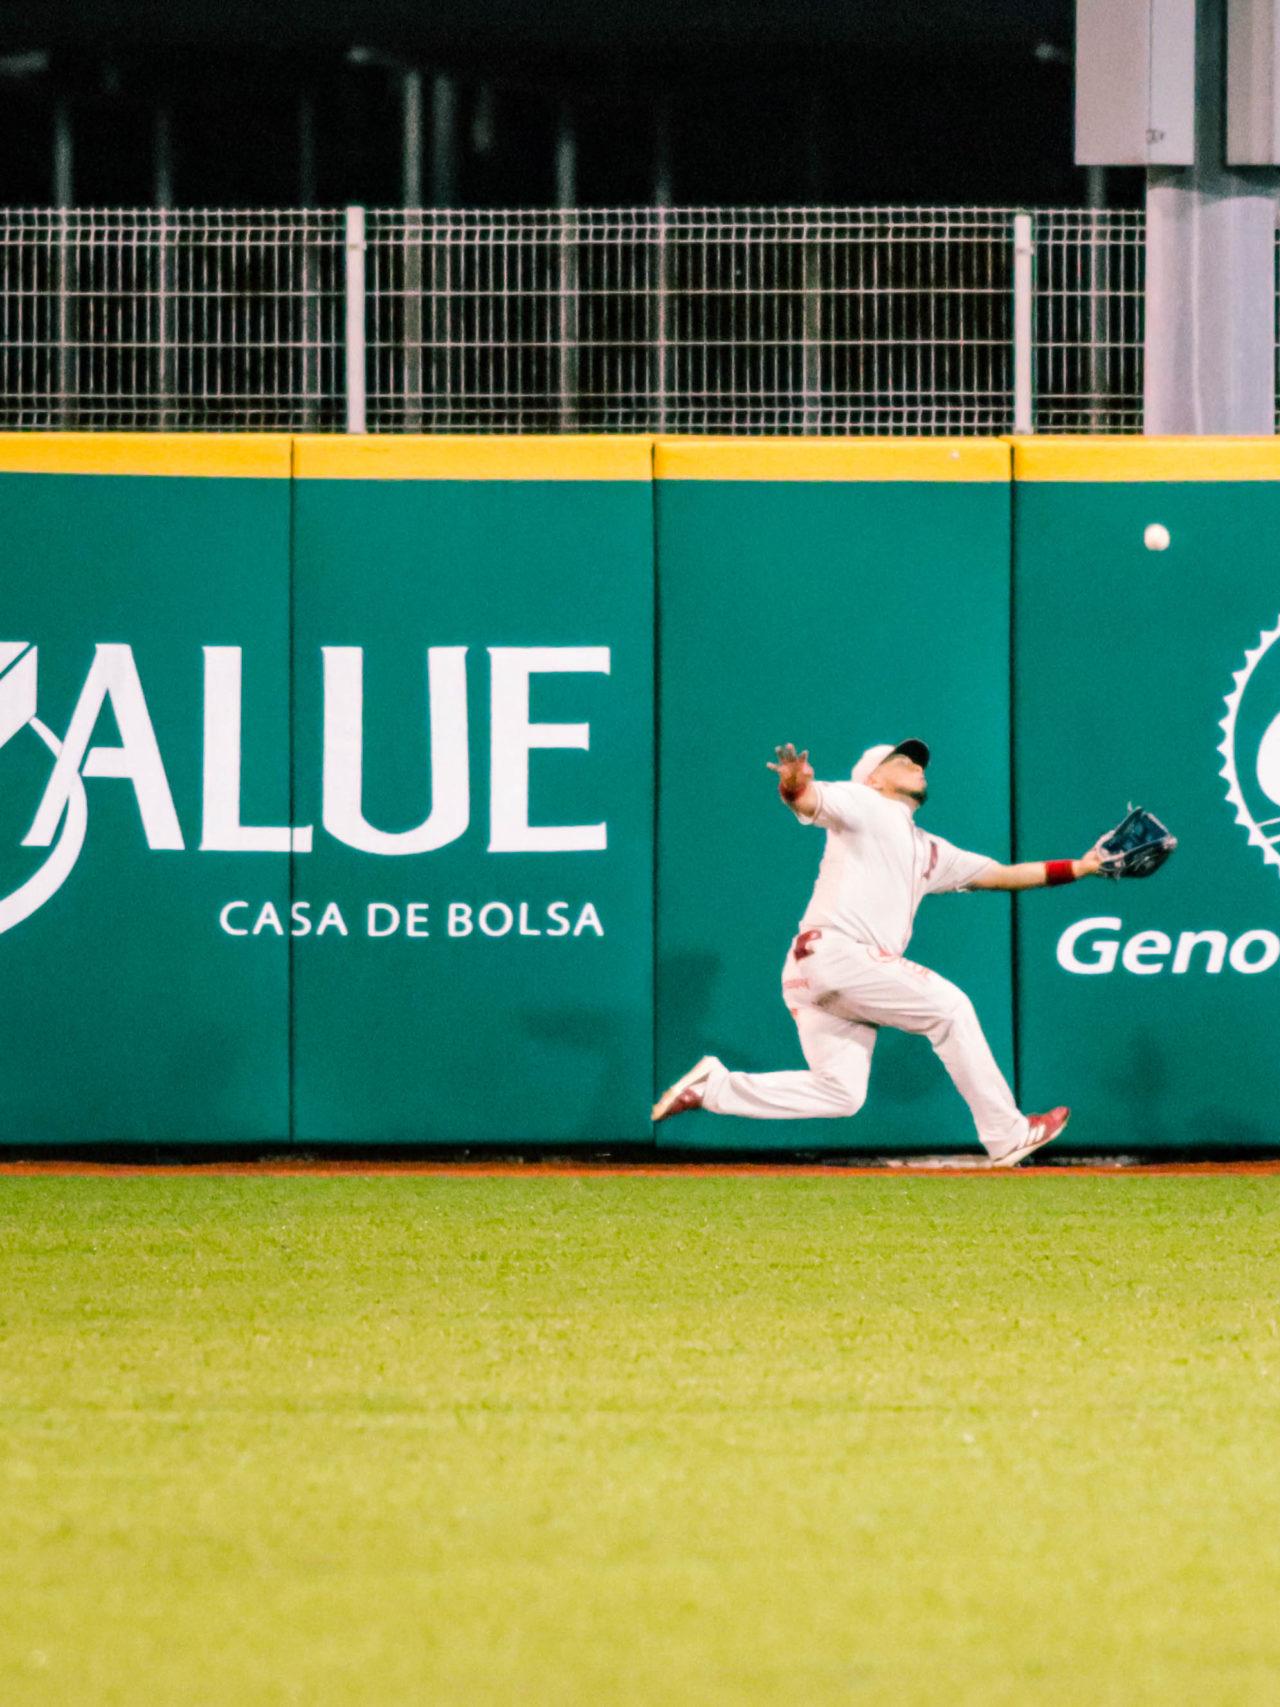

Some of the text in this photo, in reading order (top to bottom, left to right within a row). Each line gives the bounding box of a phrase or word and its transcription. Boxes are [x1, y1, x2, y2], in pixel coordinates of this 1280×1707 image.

[219, 901, 604, 937] CASA DE BOLSA
